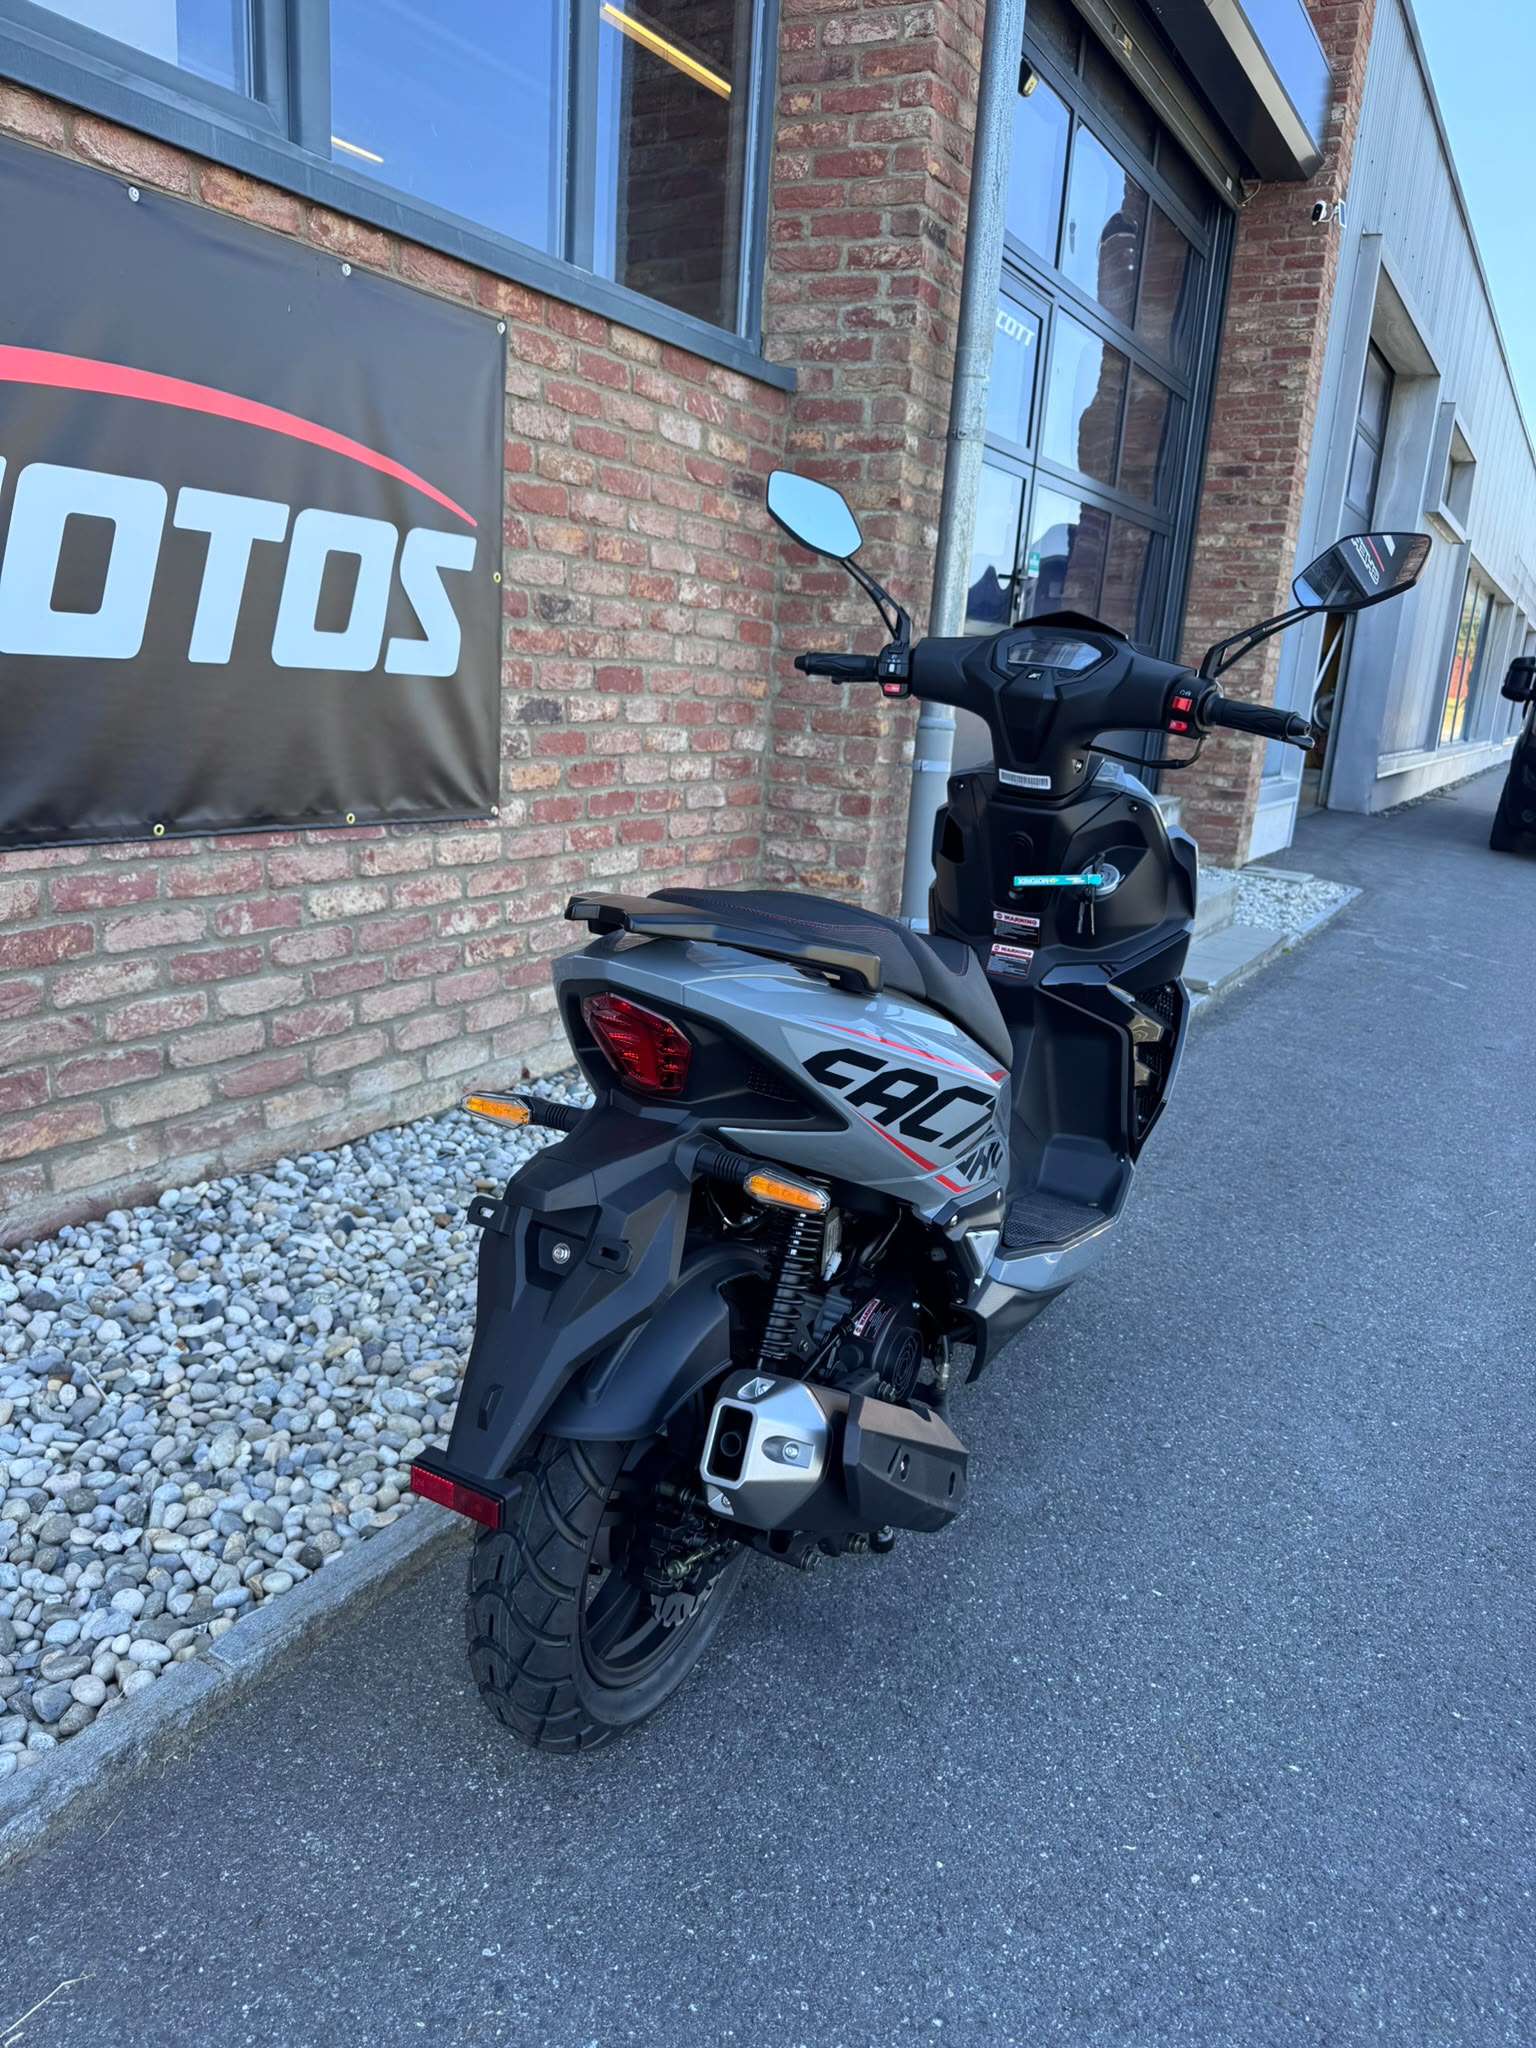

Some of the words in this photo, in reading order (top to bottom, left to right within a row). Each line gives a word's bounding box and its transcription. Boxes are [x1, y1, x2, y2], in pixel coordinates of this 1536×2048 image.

[995, 306, 1036, 347] COTT
[0, 455, 477, 677] OTOS
[1003, 914, 1037, 925] WARNING
